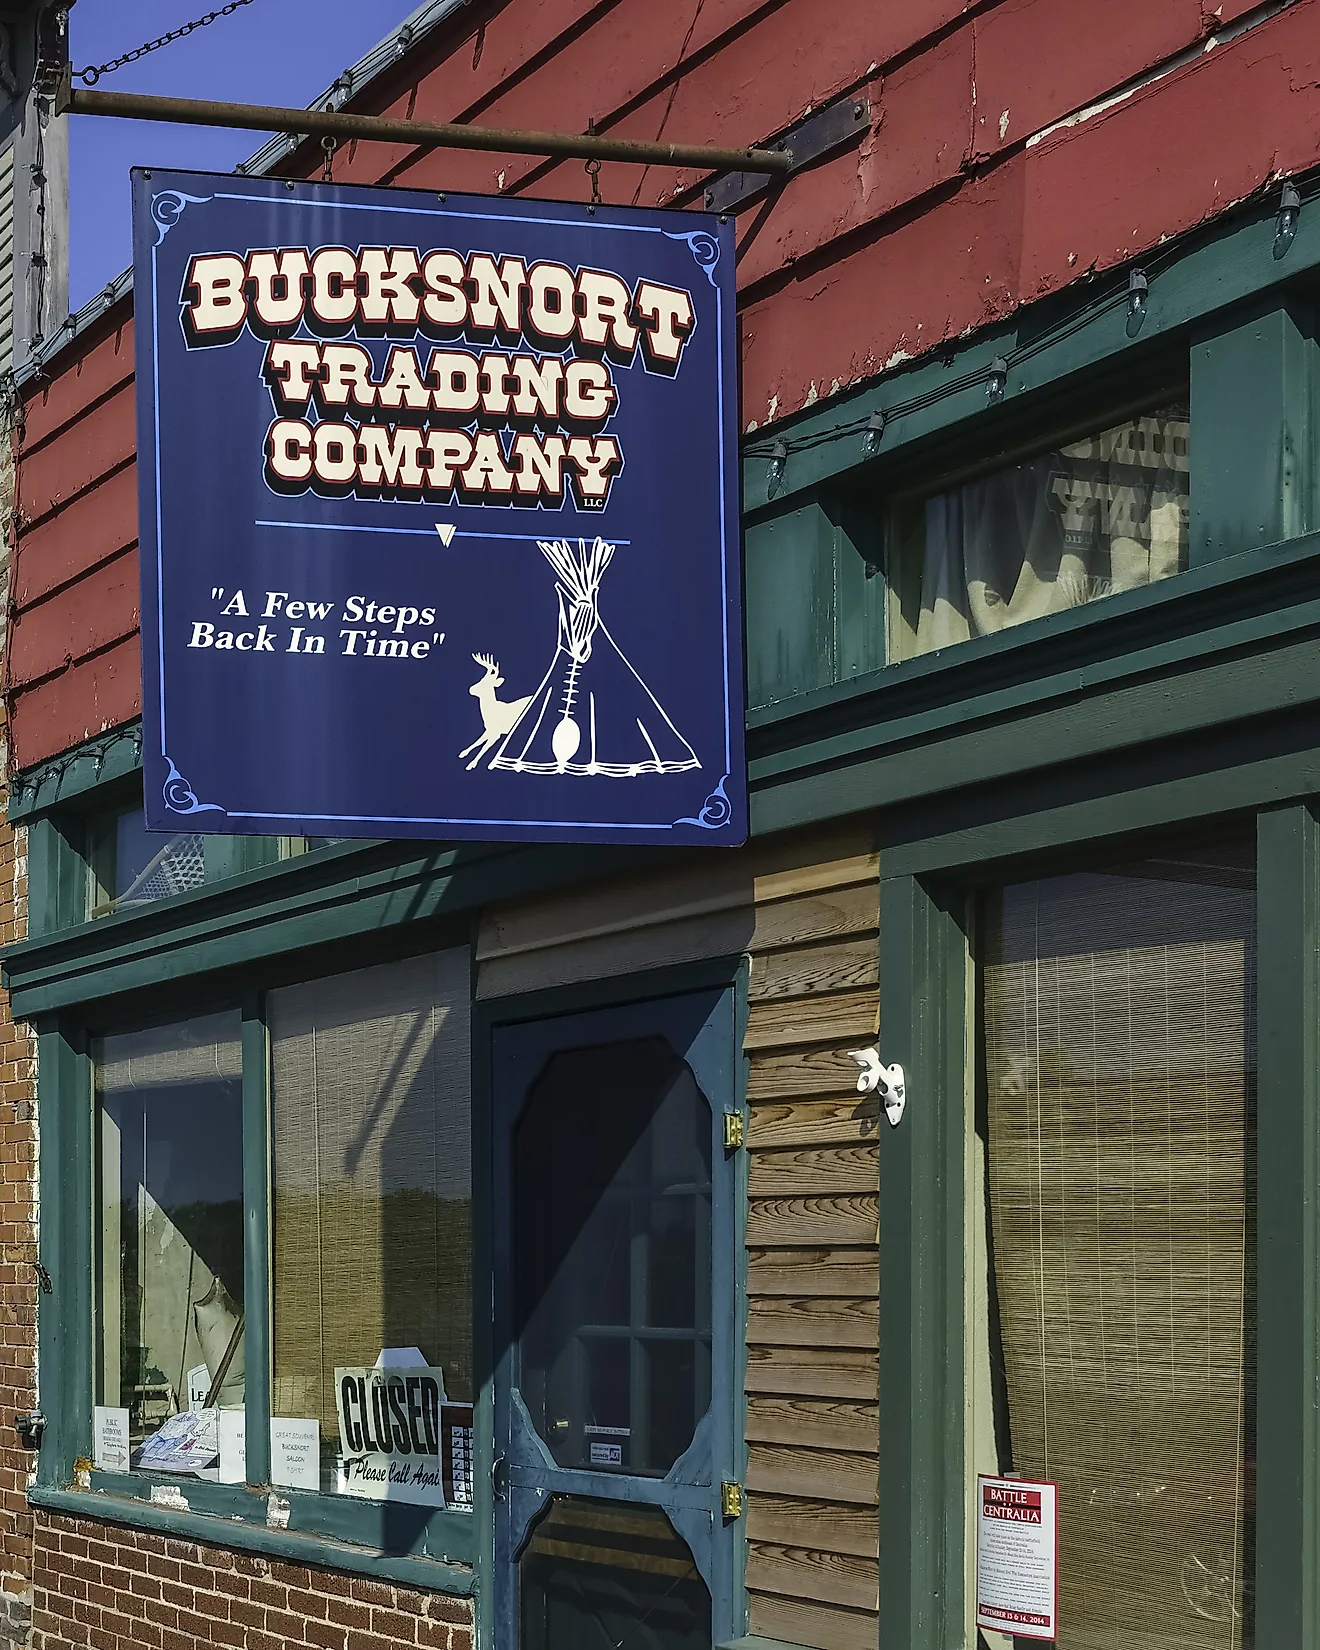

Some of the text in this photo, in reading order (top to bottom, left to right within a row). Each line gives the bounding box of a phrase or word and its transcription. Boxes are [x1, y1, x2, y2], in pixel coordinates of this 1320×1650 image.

[188, 246, 694, 363] BUCKSNORT
[269, 340, 615, 420] TRADING
[268, 417, 622, 496] COMPANY
[584, 498, 603, 508] LLC
[210, 587, 436, 634] "A Few Steps
[187, 621, 446, 660] Back In Time"
[341, 1375, 439, 1456] CLOSED
[286, 1455, 305, 1463] SALOON
[354, 1458, 440, 1491] Please Call Agai
[983, 1504, 1040, 1522] CENTRALIA
[990, 1488, 1027, 1503] BATTLE
[981, 1607, 1006, 1618] SEPTEMBER
[1029, 1616, 1045, 1624] 2014
